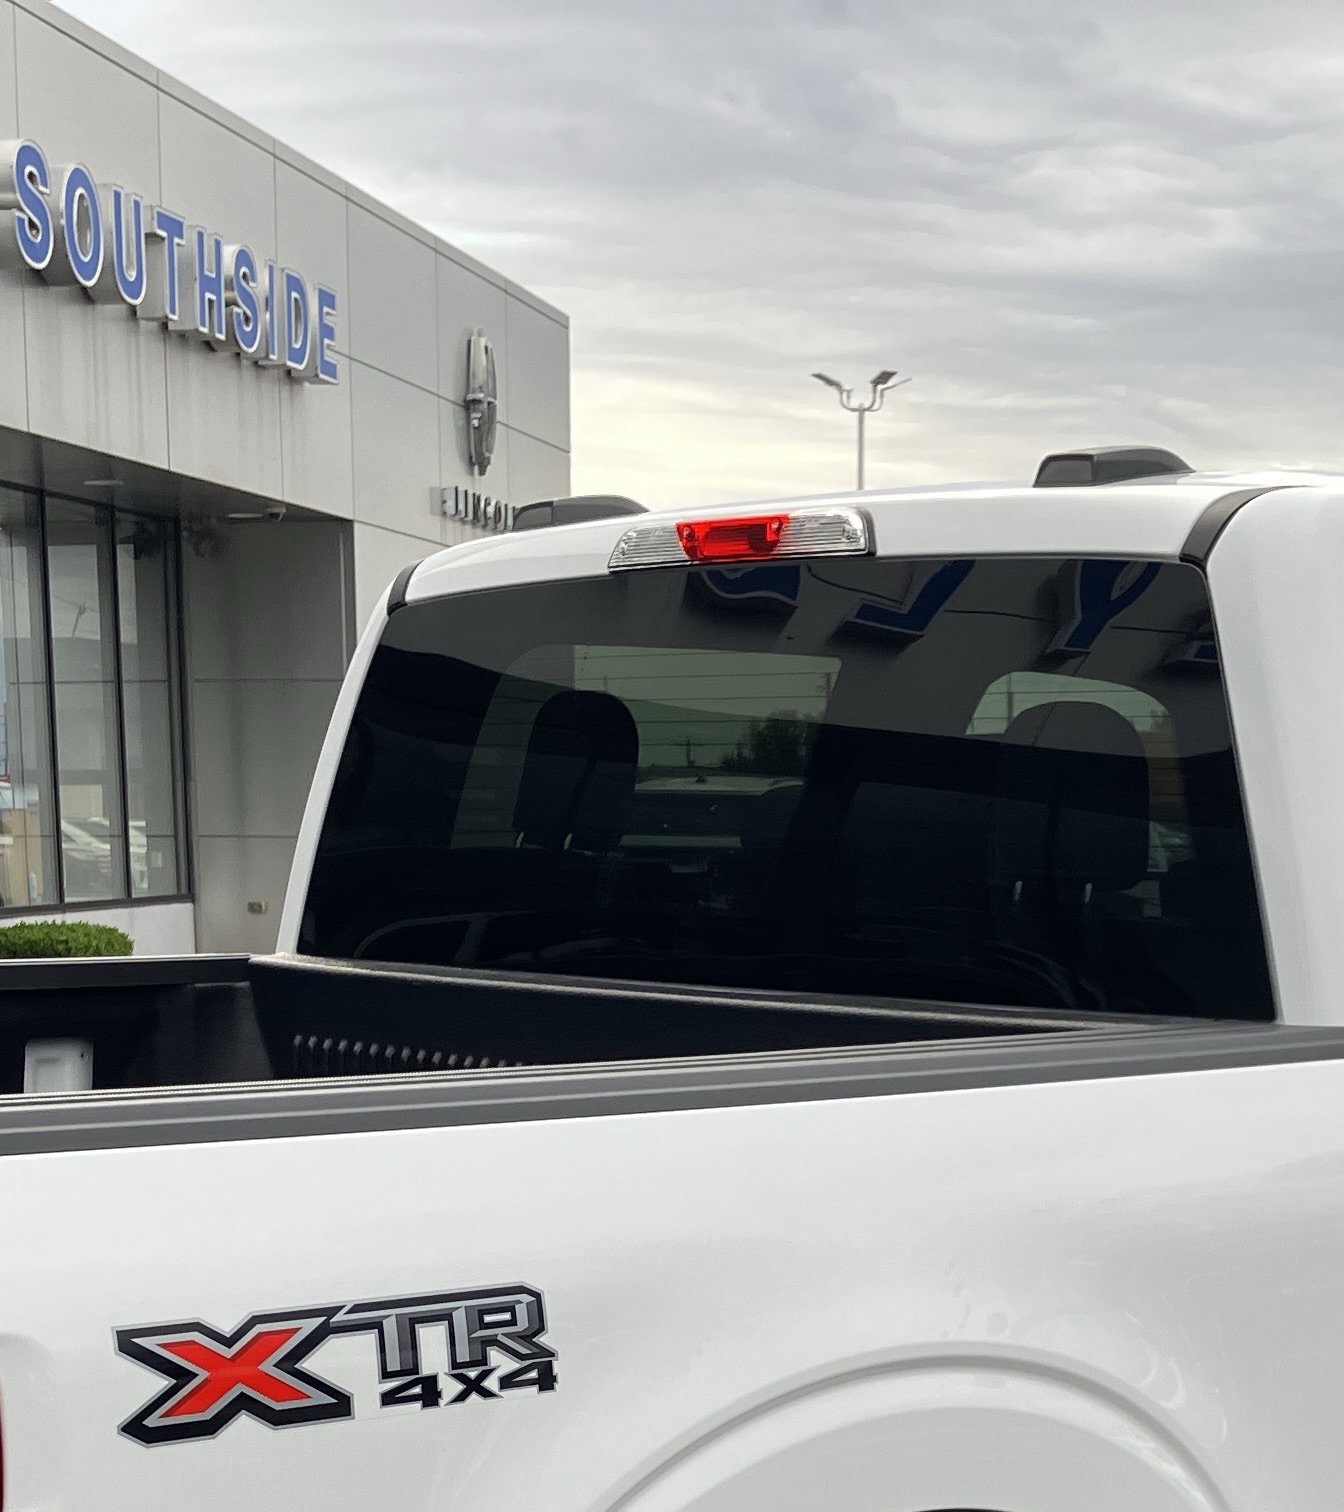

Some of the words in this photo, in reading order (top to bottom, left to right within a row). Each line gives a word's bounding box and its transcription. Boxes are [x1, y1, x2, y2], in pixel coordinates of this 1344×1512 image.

[10, 138, 341, 385] SOUTHSIDE
[440, 486, 518, 532] LINCOL
[111, 1281, 559, 1448] XTR
